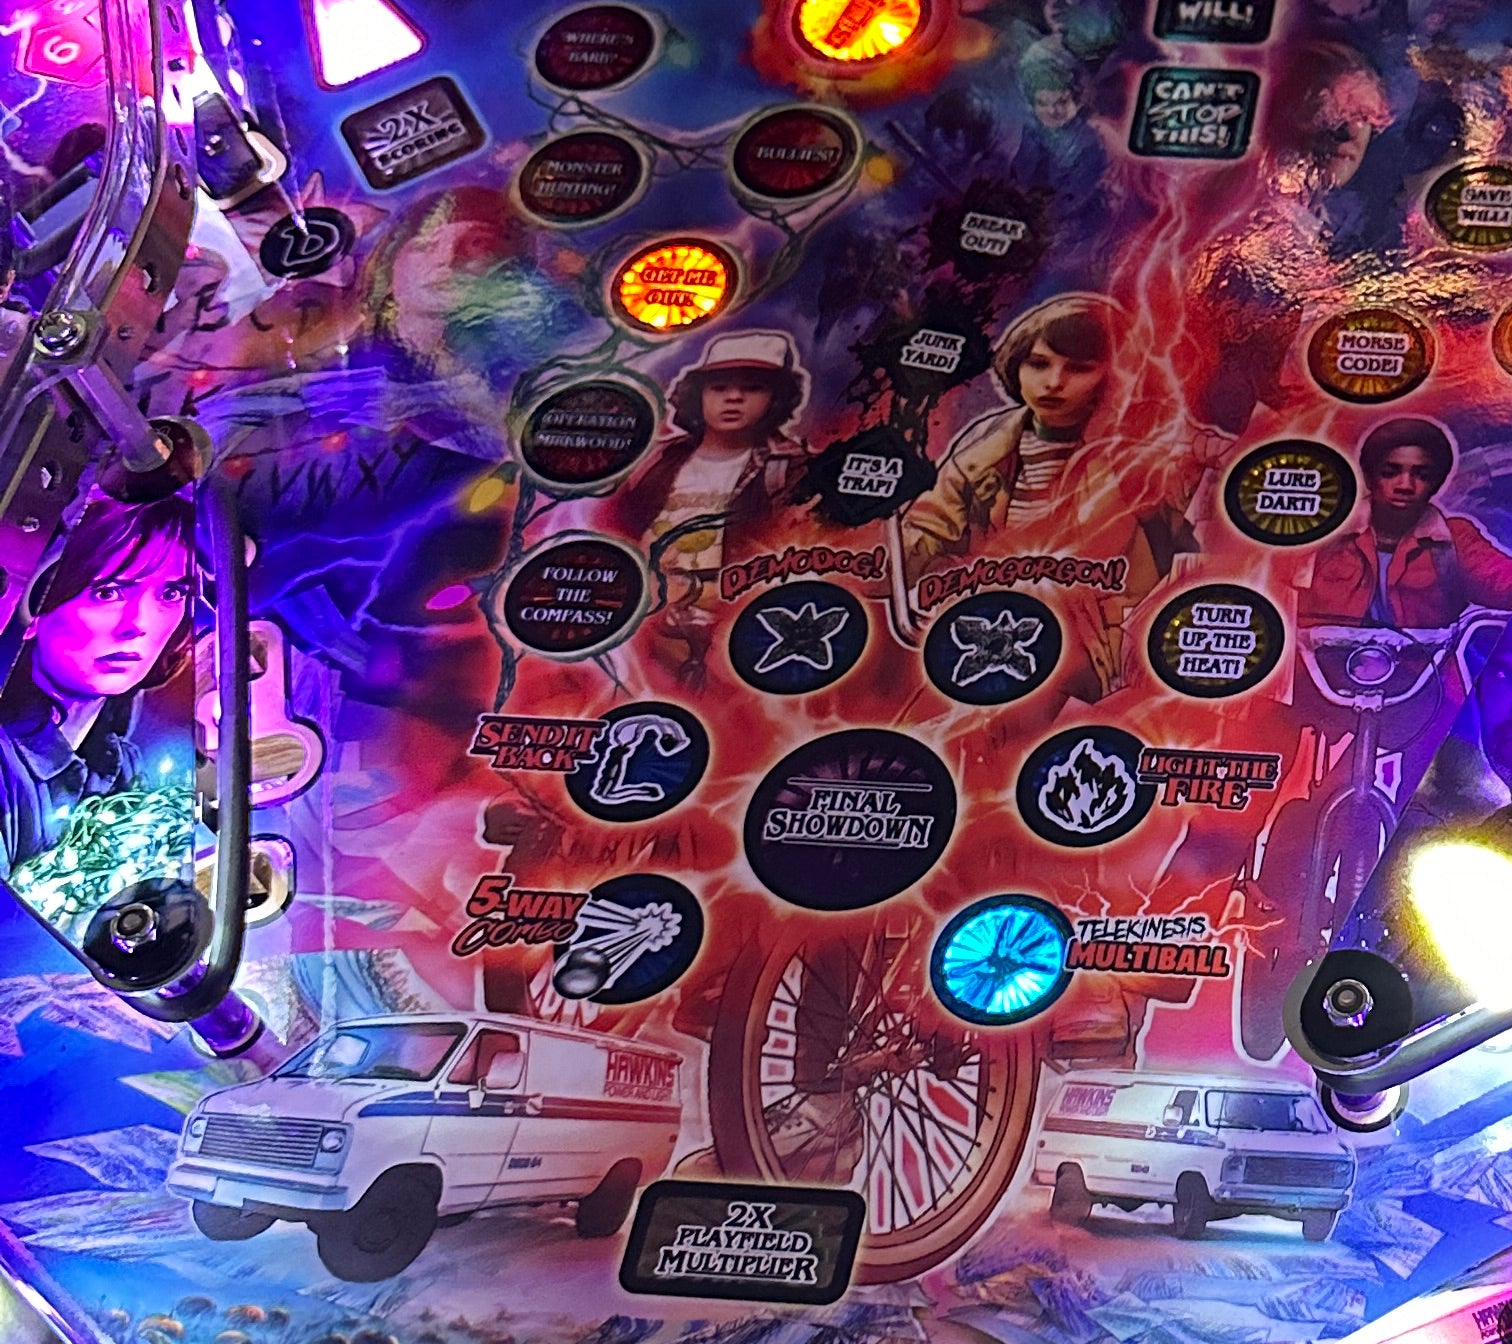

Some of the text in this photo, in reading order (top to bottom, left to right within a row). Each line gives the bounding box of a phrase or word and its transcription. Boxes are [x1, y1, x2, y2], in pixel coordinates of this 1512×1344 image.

[1178, 0, 1255, 24] WILL!
[1154, 80, 1245, 101] CAN'T
[379, 101, 437, 144] 2X
[1147, 101, 1243, 125] STOP
[1151, 124, 1231, 149] THIS!
[963, 214, 1024, 238] BREAK
[962, 233, 1010, 254] OUT!
[641, 268, 684, 284] GET
[914, 331, 963, 352] JUNK
[1340, 333, 1407, 352] MORSE
[902, 348, 958, 372] YARD!
[1339, 355, 1401, 374] CODE!
[845, 455, 902, 476] IT'S A
[840, 475, 896, 496] TRAP!
[1266, 470, 1318, 489] LURE
[1257, 493, 1318, 513] DART!
[542, 565, 619, 584] FOLLOW
[721, 547, 886, 600] DEMODOG!
[918, 556, 1127, 611] DEMOGORGON!
[556, 587, 592, 603] THE
[520, 606, 614, 626] COMPASS!
[1195, 605, 1248, 625] TURN
[1181, 631, 1252, 651] UP THE
[1181, 656, 1241, 675] HEAT!
[477, 721, 599, 753] SEND IT
[494, 746, 575, 771] BACK
[1140, 754, 1279, 780] LIGHT THE
[809, 789, 901, 814] FINAL
[1162, 775, 1249, 811] FIRE
[764, 809, 934, 849] SHOWDOWN
[468, 876, 588, 919] 5-WAY
[1077, 916, 1207, 943] TELEKINESIS
[1066, 940, 1230, 978] MULTIBALL
[724, 1202, 776, 1230] 2X
[675, 1226, 812, 1254] PLAYFIELD
[656, 1247, 818, 1284] MULTIPLIER
